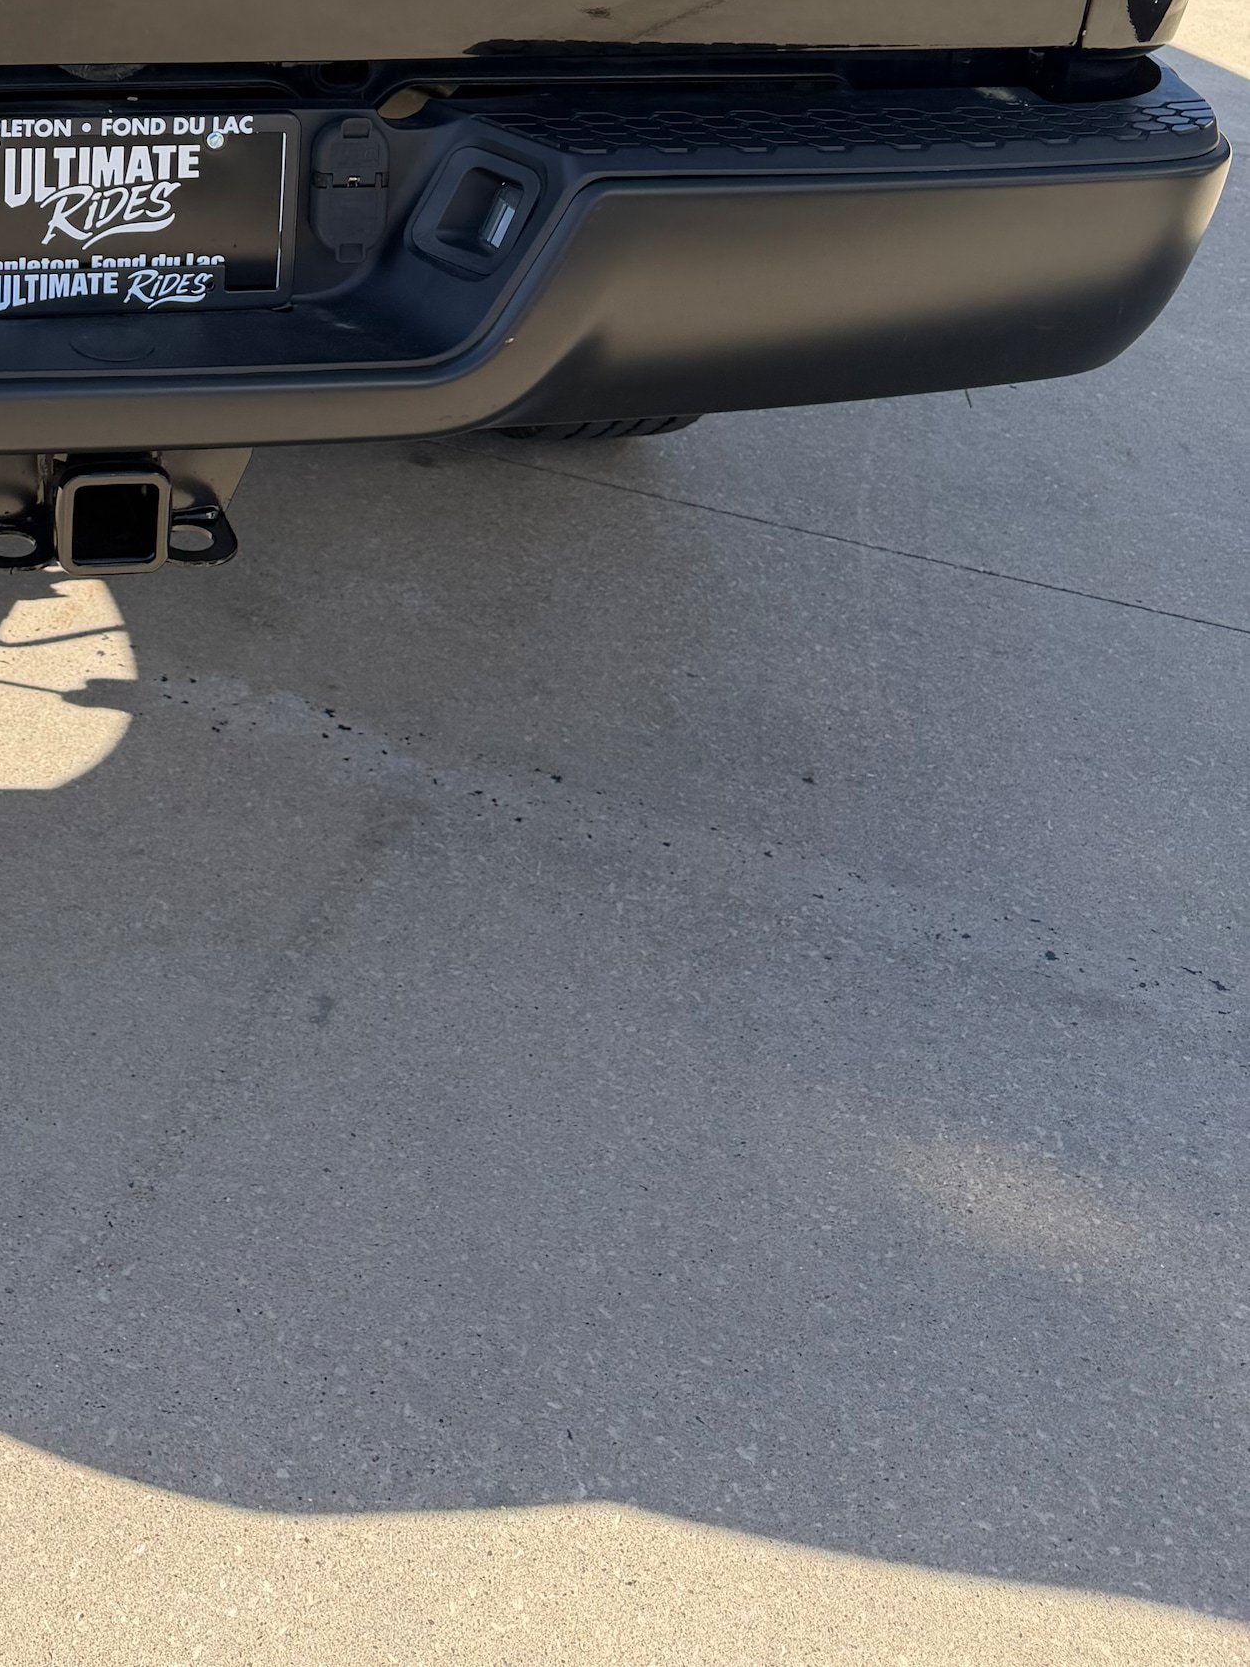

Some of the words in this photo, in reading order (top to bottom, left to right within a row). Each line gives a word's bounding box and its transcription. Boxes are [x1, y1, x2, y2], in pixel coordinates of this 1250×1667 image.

[101, 117, 166, 136] FOND
[173, 117, 205, 135] DU
[212, 116, 254, 135] LAC
[4, 144, 200, 209] ULTIMATE
